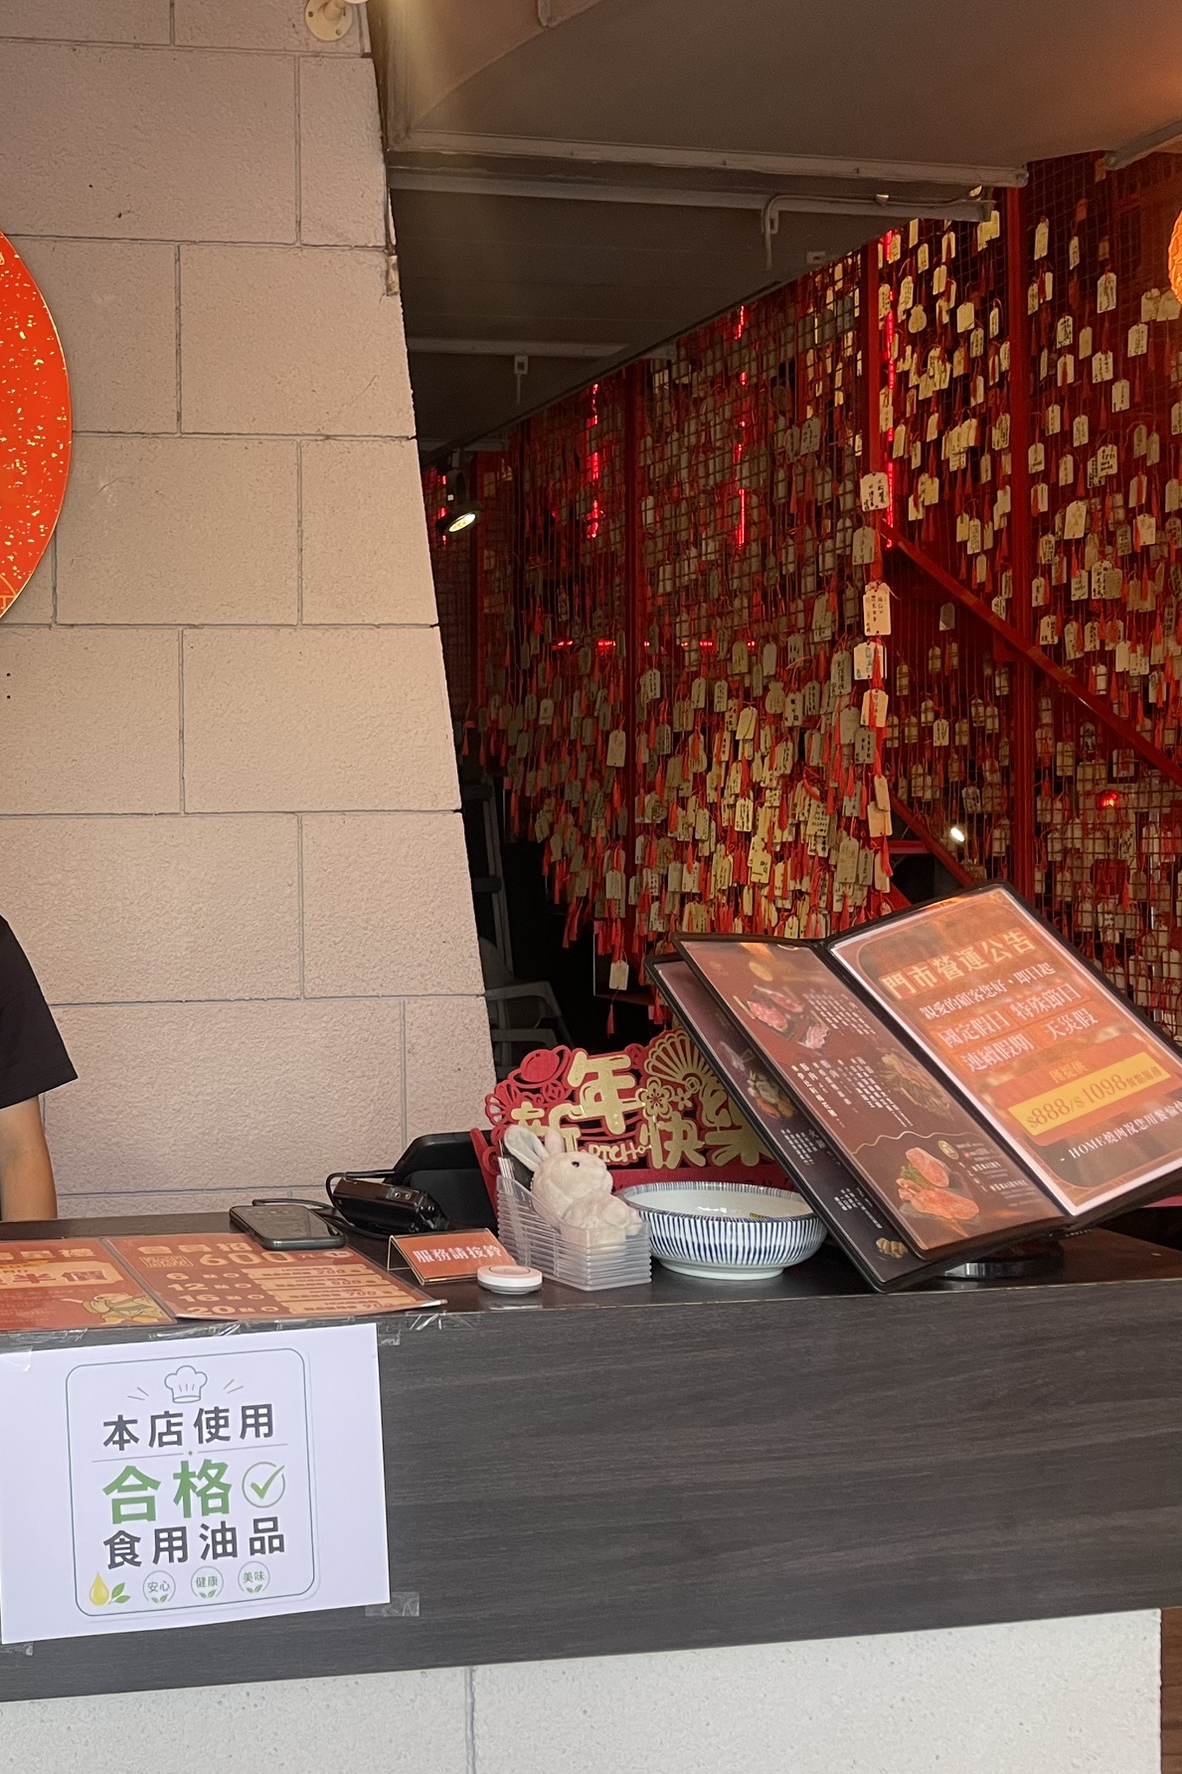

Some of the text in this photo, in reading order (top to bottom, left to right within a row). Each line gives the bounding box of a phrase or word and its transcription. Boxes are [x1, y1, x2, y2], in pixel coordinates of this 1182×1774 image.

[879, 928, 1039, 1000] 門市營運公告
[936, 982, 1083, 1049] 國定假日 特殊節日
[958, 1006, 1100, 1075] 連續假期 天災假
[200, 1251, 296, 1266] 600
[412, 1244, 501, 1263] 服務請按鈴
[168, 1283, 208, 1291] 12
[179, 1294, 220, 1302] 16
[102, 1403, 275, 1451] 本店使用
[102, 1458, 233, 1525] 合格
[103, 1516, 286, 1570] 食用油品
[147, 1571, 266, 1594] 安心 健康 美味
